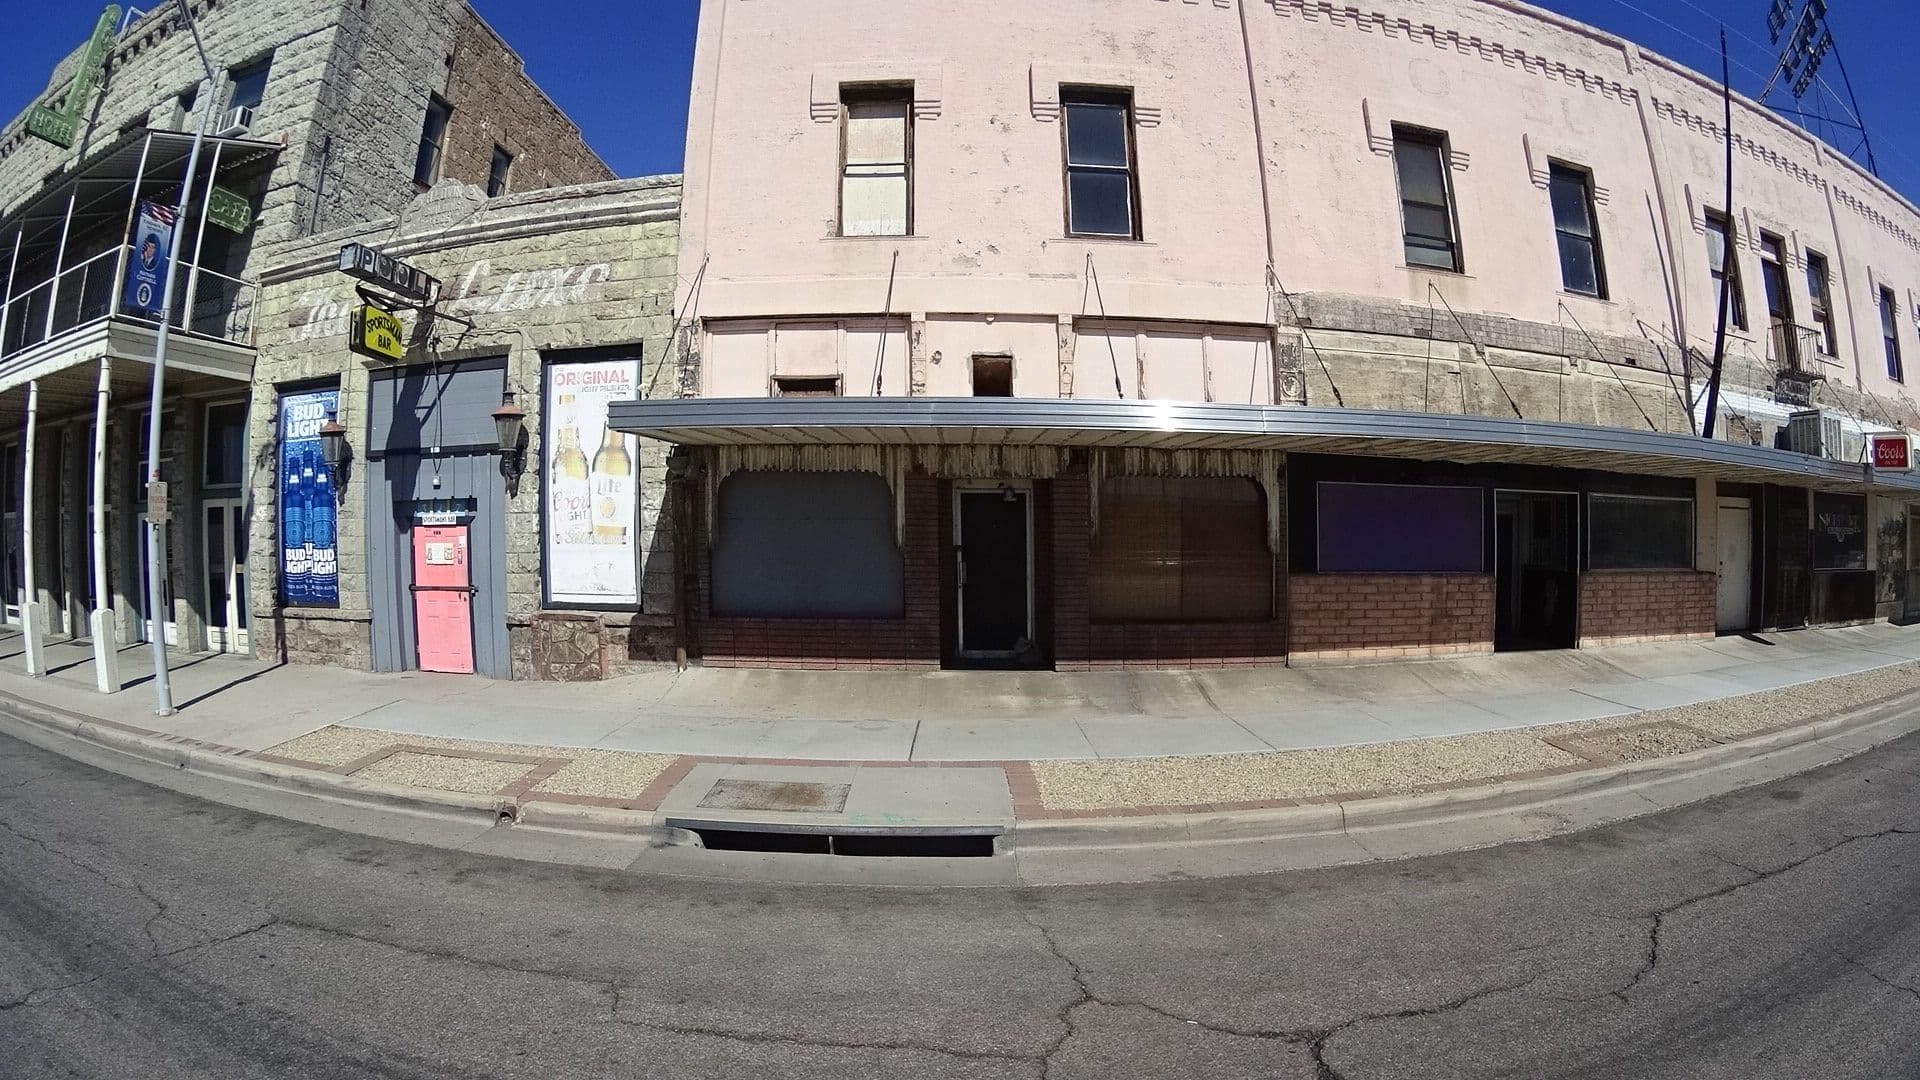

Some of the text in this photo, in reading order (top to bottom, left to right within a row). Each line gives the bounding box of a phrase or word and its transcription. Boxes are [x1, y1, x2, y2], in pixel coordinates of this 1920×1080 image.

[33, 112, 72, 139] HOTEL
[210, 193, 250, 222] CAFE
[362, 247, 425, 293] POOL
[366, 317, 402, 345] SPORTSMAN
[378, 335, 391, 351] BAR
[293, 402, 324, 421] BUD
[1877, 442, 1905, 460] Coors
[285, 549, 306, 561] BUD
[313, 549, 335, 561] BUD
